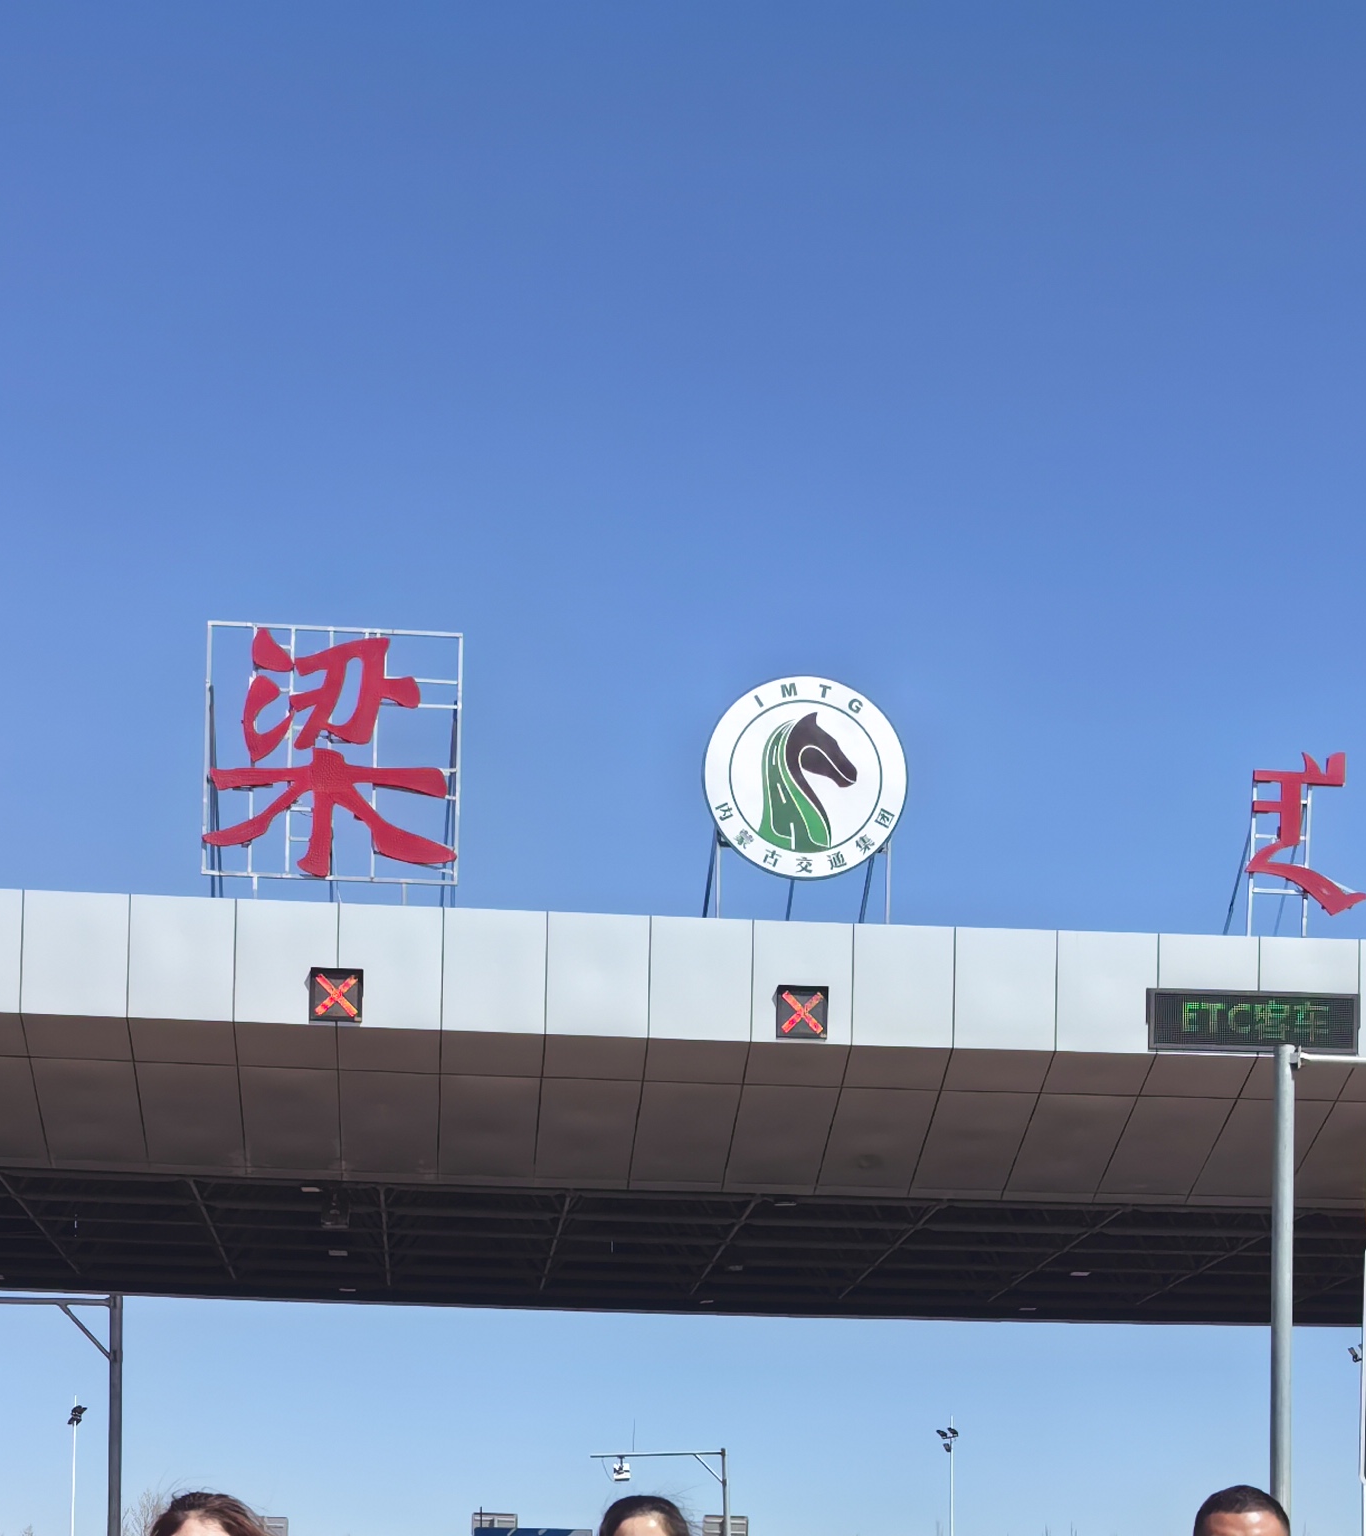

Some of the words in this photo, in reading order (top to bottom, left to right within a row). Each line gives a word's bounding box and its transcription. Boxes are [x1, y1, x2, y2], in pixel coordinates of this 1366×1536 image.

[754, 683, 864, 714] IMTG
[715, 803, 895, 874] 内蒙古交通集团
